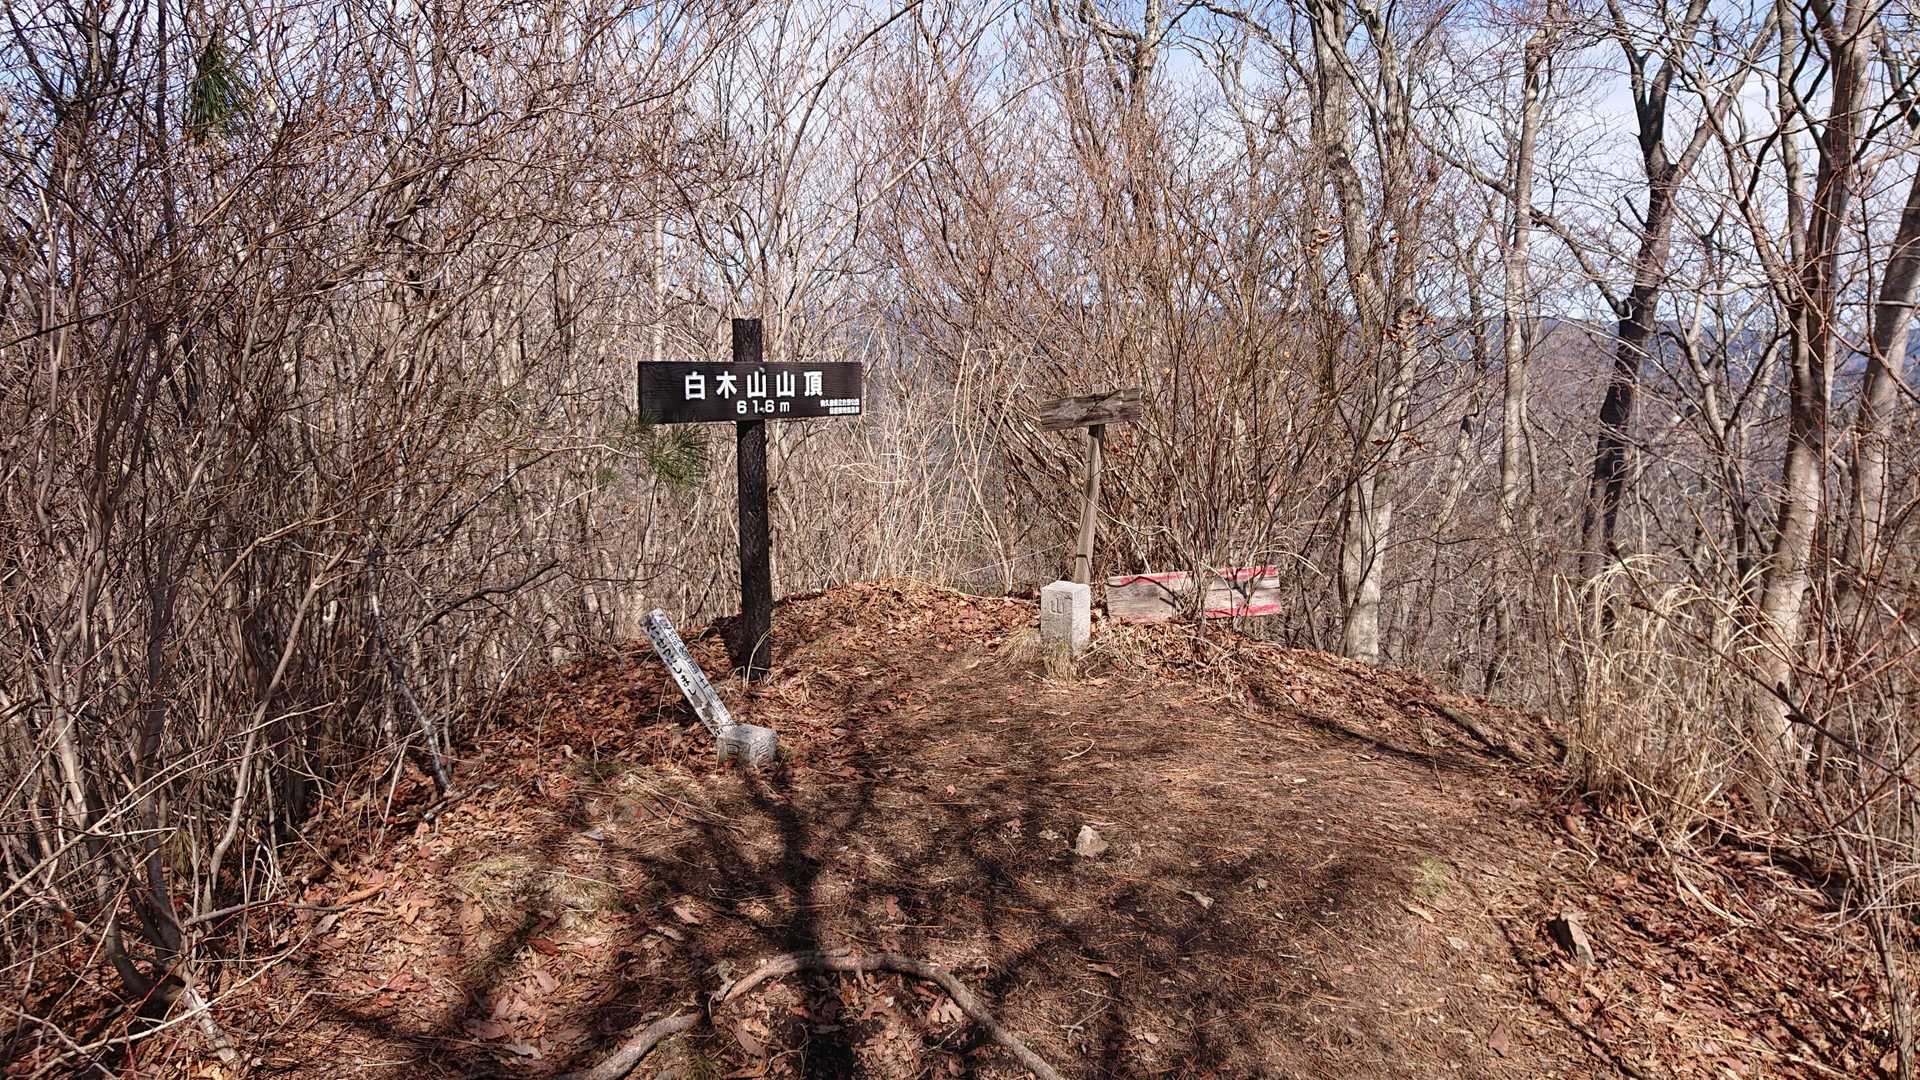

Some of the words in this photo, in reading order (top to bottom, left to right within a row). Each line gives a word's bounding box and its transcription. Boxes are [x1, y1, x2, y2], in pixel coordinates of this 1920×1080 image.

[684, 370, 823, 400] 白木山山頂
